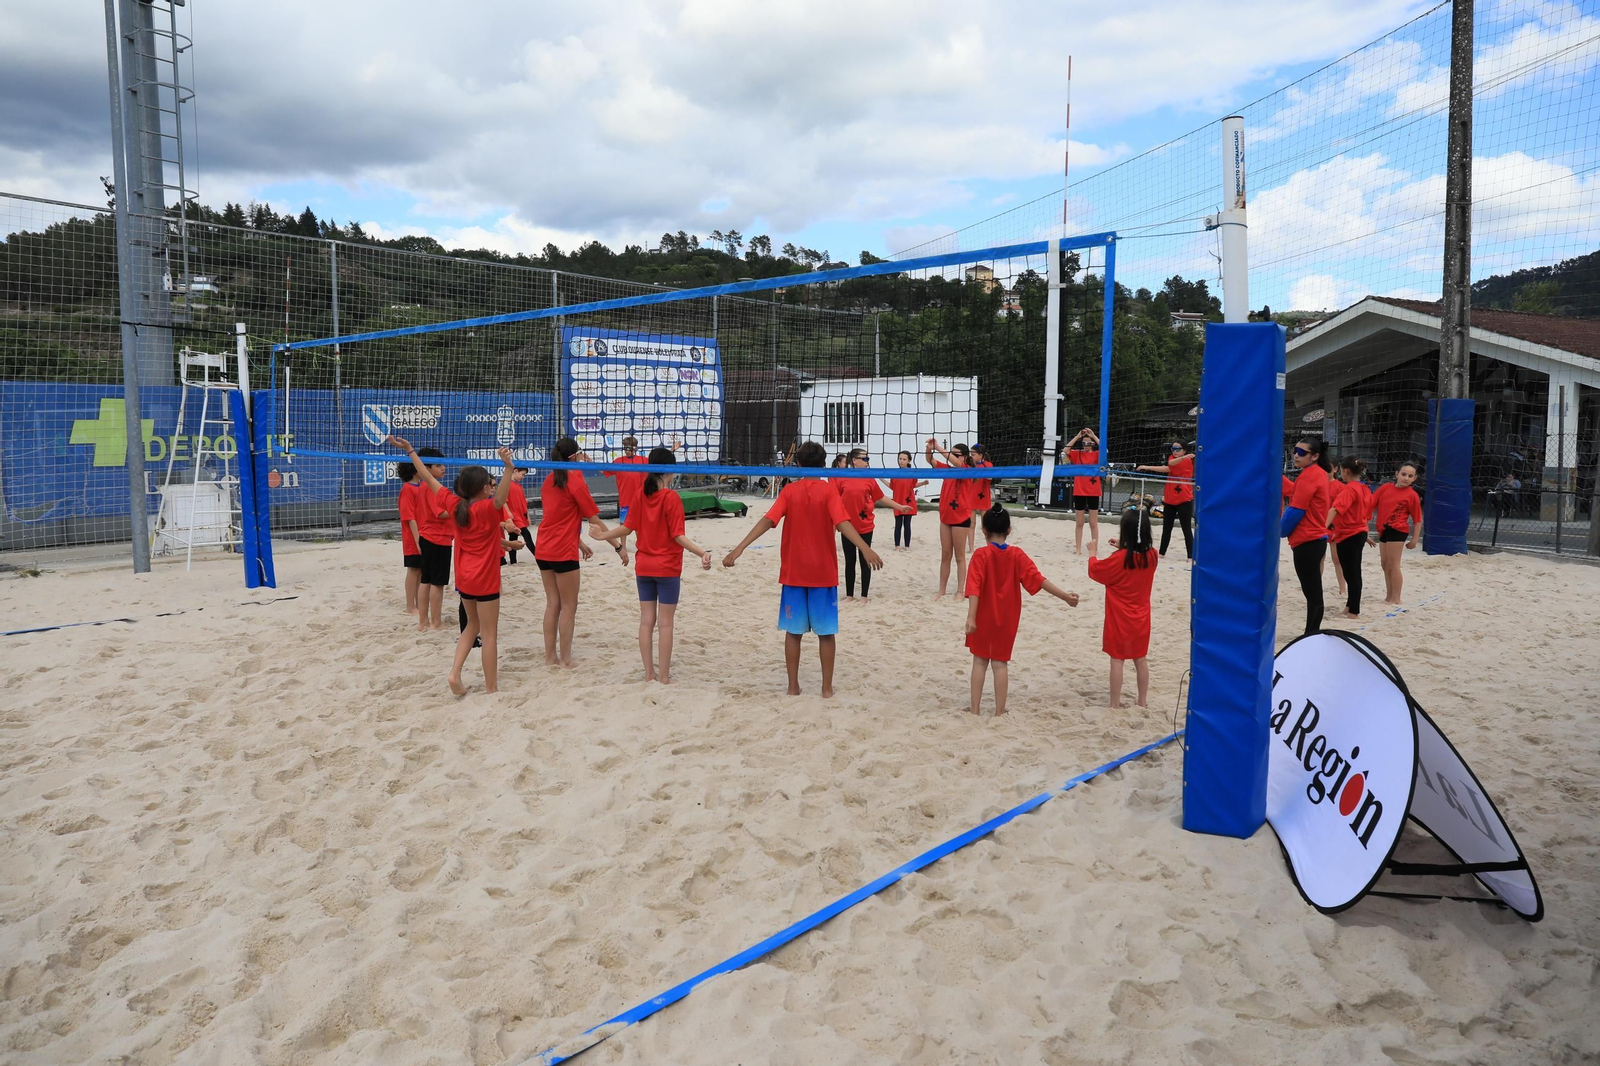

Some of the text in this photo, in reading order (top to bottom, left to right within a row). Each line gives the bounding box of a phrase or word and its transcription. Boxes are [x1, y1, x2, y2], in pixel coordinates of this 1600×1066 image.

[612, 344, 628, 353] CLUB
[628, 345, 653, 356] OURENSE
[393, 406, 441, 416] DEPORTE
[393, 417, 436, 427] GALEGO
[1283, 698, 1383, 850] Región
